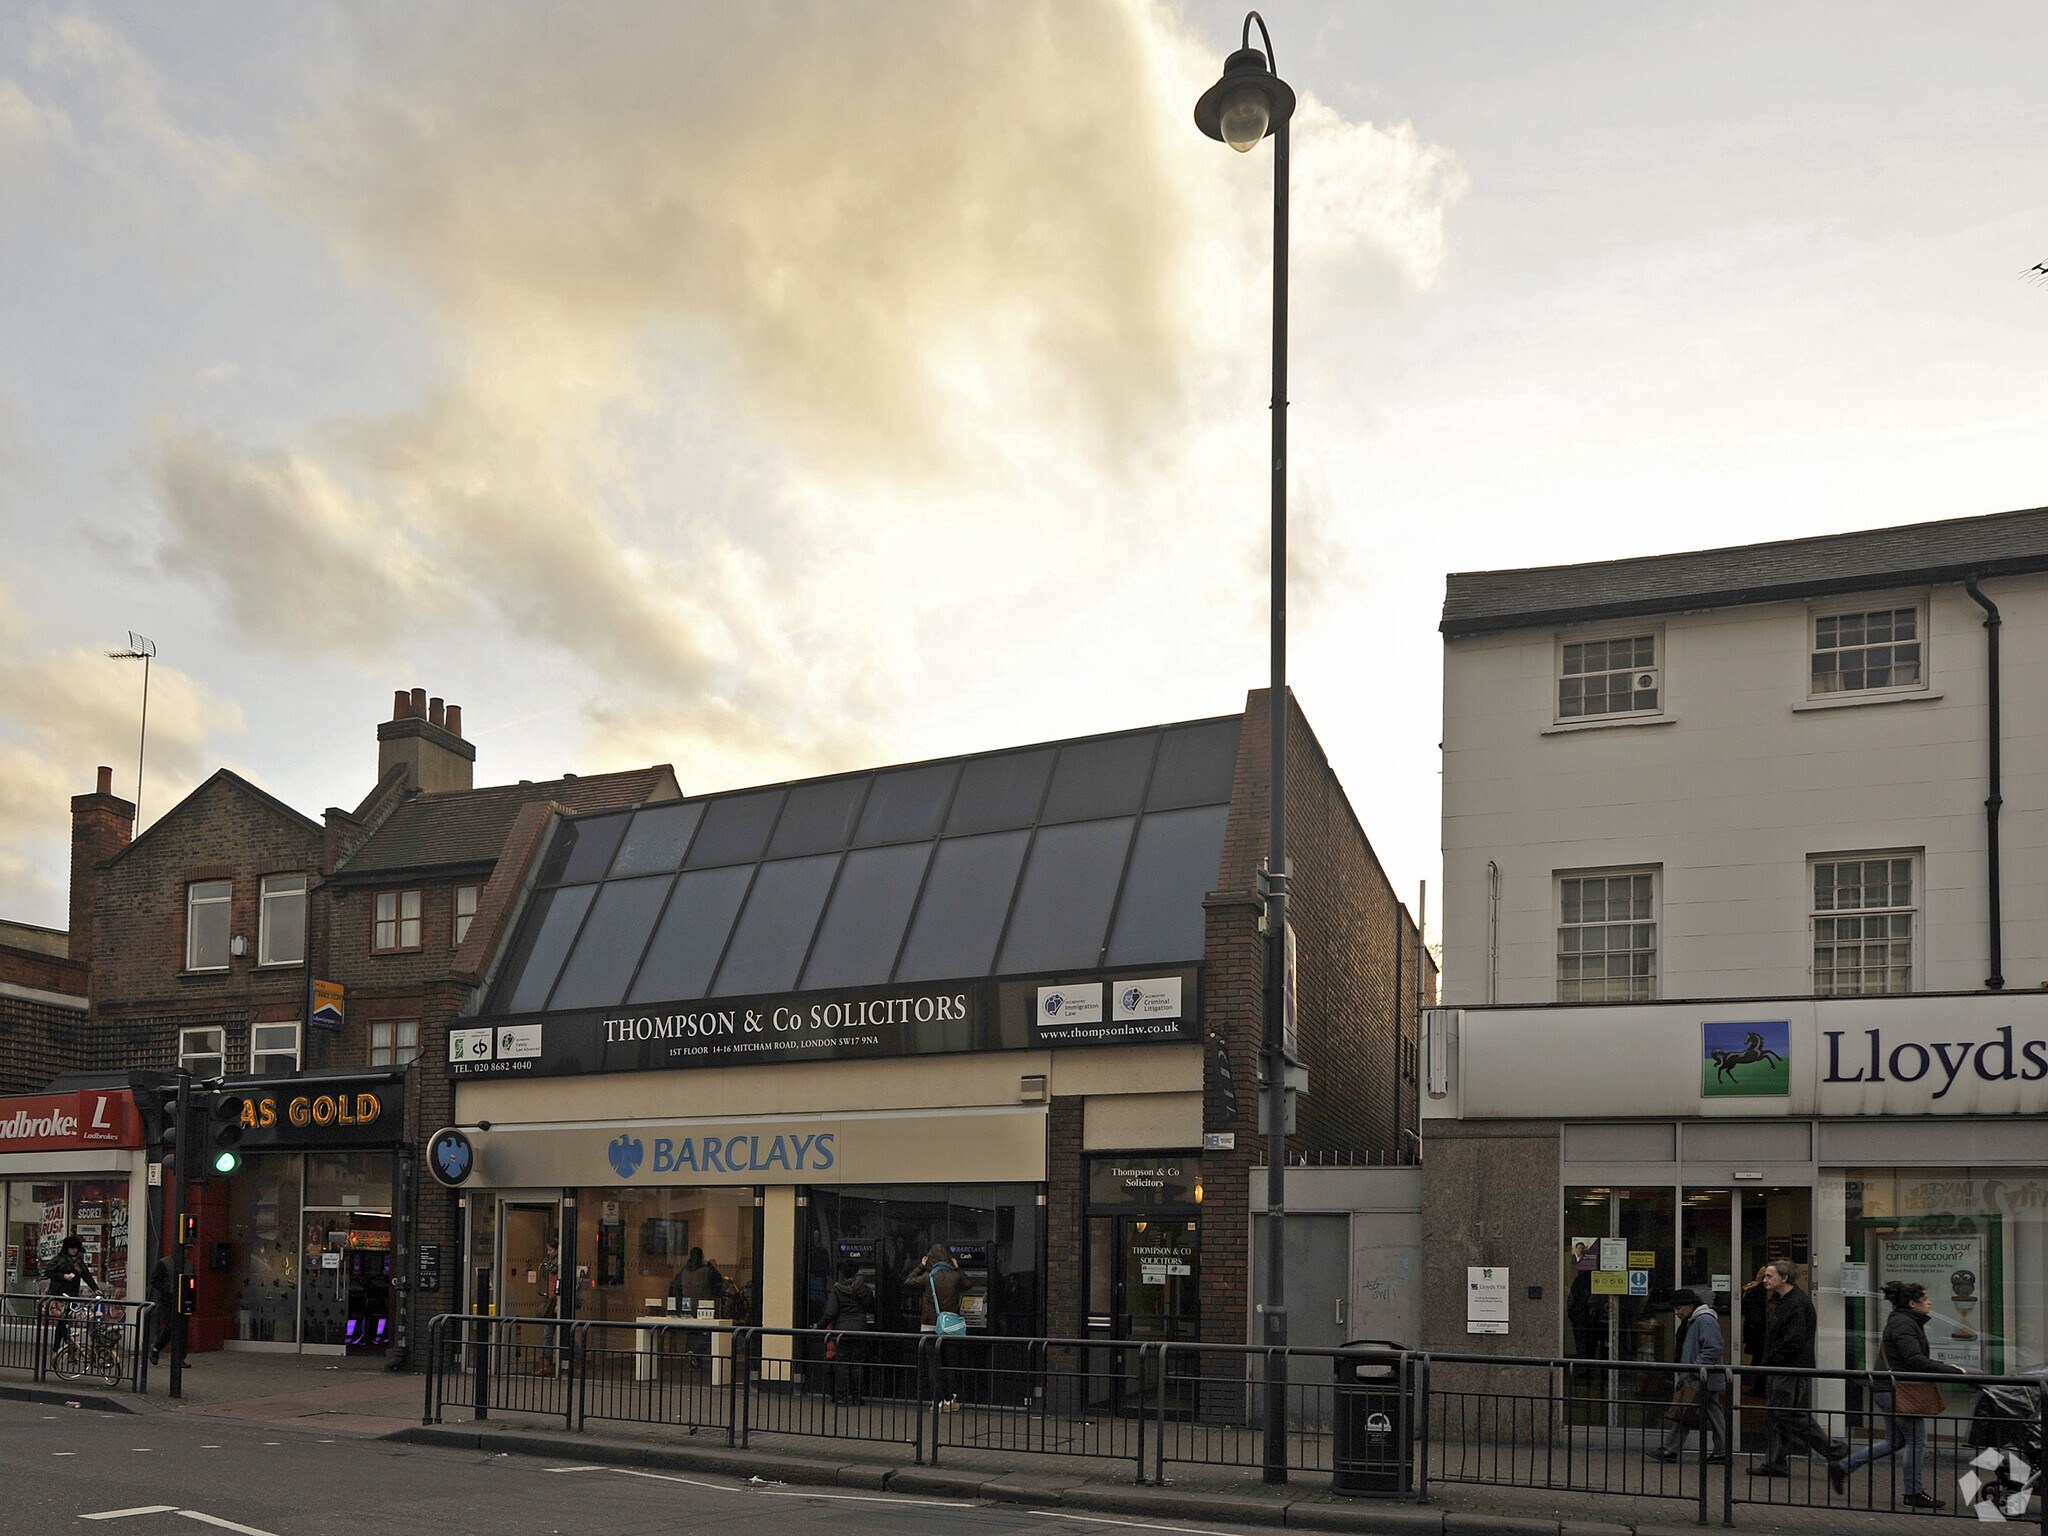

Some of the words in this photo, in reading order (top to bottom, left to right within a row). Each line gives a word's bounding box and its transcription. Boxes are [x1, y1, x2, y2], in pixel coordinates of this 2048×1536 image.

[1144, 998, 1170, 1006] Criminal
[603, 1010, 736, 1043] THOMPSON
[743, 1009, 764, 1033] &
[773, 1007, 802, 1032] Co
[810, 994, 967, 1029] SOLICITORS
[1040, 1021, 1179, 1039] www.thompsonlaw.co.uk
[669, 1048, 682, 1056] 1ST
[684, 1047, 708, 1055] FLOOR
[712, 1045, 732, 1054] 14-16
[733, 1042, 773, 1053] MITCHAM
[774, 1040, 799, 1050] ROAD,
[800, 1038, 837, 1048] LONDON
[838, 1037, 859, 1046] SW17
[861, 1036, 879, 1045] 9NA
[453, 1064, 472, 1073] TEL.
[474, 1063, 489, 1072] 020
[491, 1062, 510, 1071] 8682
[512, 1061, 532, 1070] 4040
[1823, 1025, 2048, 1099] Lloyds
[91, 1096, 111, 1129] L
[240, 1098, 278, 1130] AS
[288, 1093, 381, 1128] GOLD
[83, 1132, 118, 1140] Ladbrokes
[652, 1133, 835, 1173] BARCLAYS
[1111, 1167, 1154, 1177] Thompson
[1156, 1168, 1165, 1176] &
[1167, 1167, 1180, 1176] Co
[1125, 1178, 1164, 1187] Solicitors
[77, 1207, 102, 1219] SCORE!
[1132, 1246, 1171, 1255] THOMPSON
[1172, 1247, 1179, 1255] &
[1180, 1247, 1192, 1255] CO
[1886, 1242, 1908, 1251] How
[1909, 1243, 1937, 1251] smart
[1940, 1242, 1948, 1251] is
[1949, 1243, 1971, 1253] your
[1140, 1256, 1183, 1265] SOLICITORS
[1886, 1252, 1918, 1261] current
[1920, 1252, 1964, 1261] account?
[1947, 1352, 1967, 1360] Lloyds
